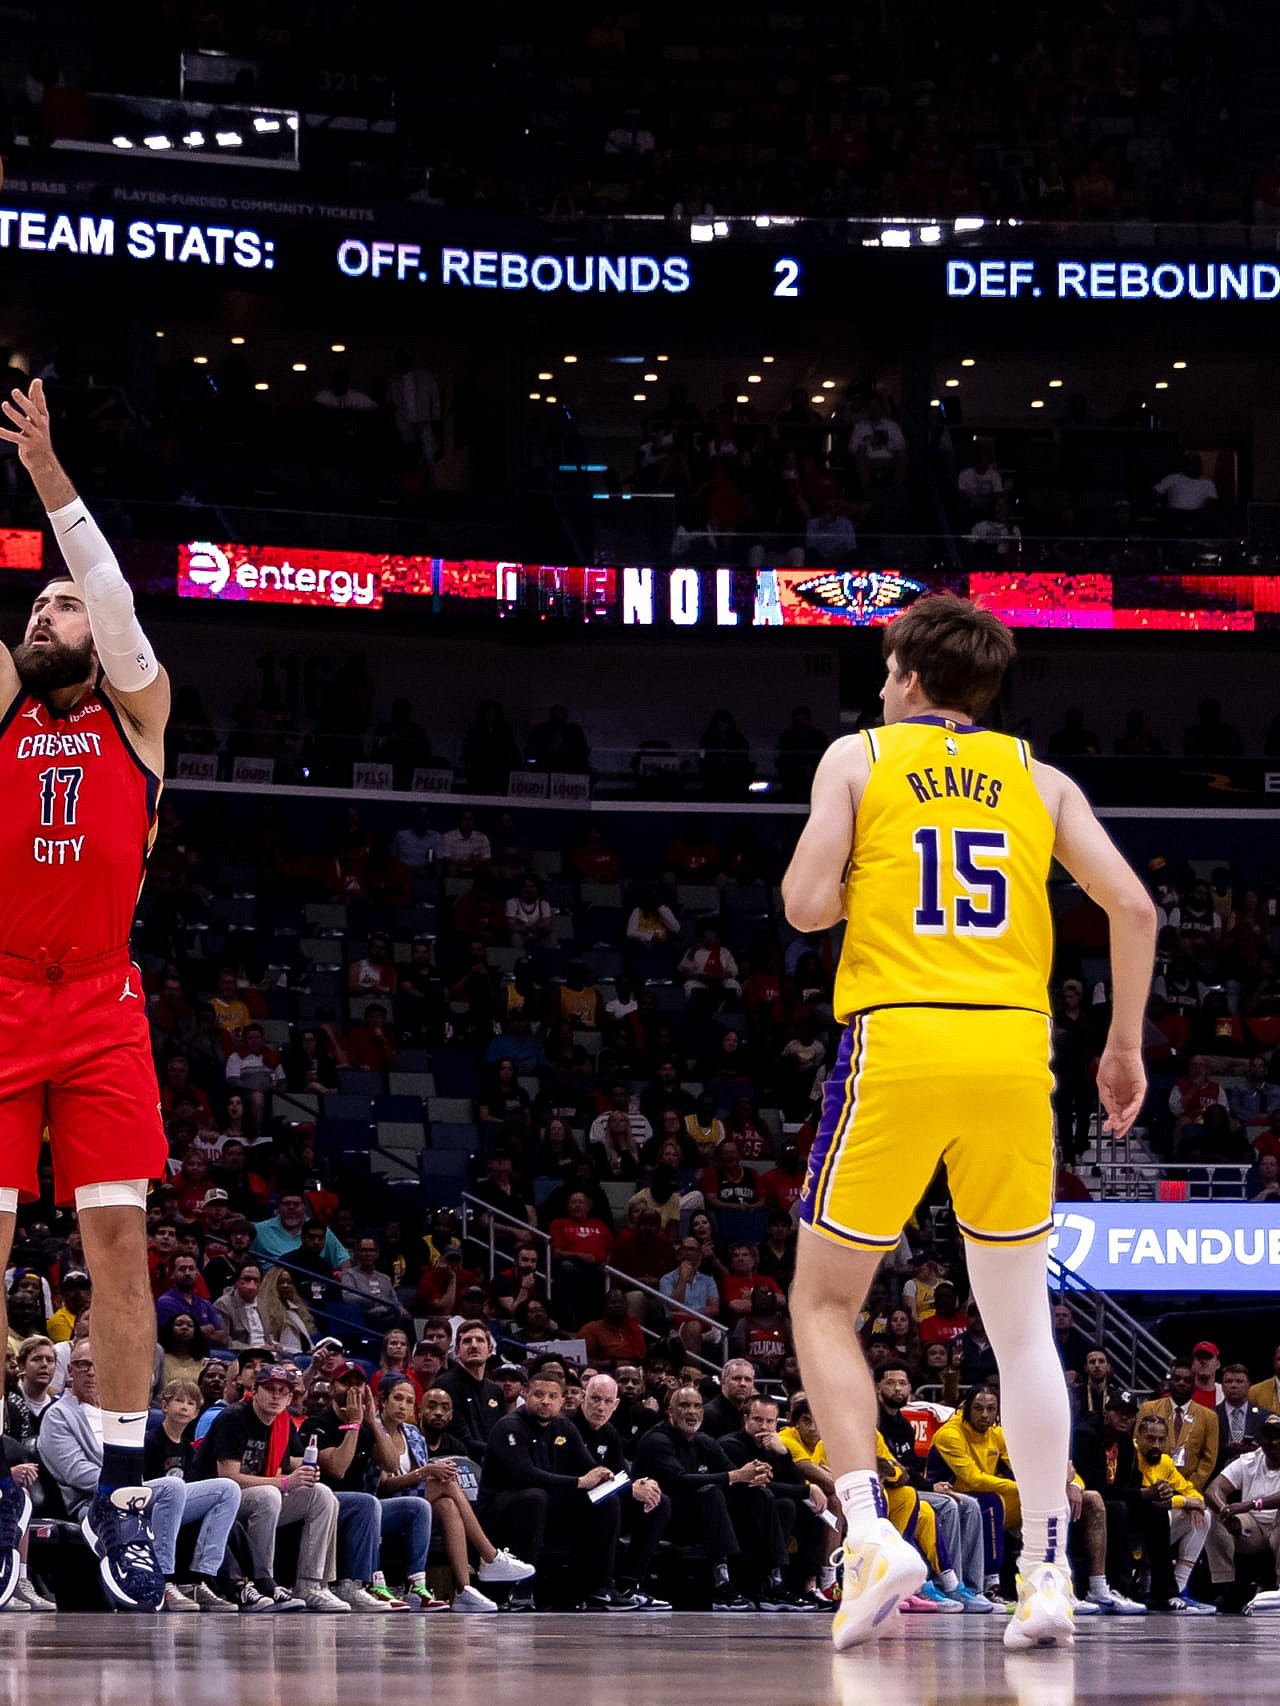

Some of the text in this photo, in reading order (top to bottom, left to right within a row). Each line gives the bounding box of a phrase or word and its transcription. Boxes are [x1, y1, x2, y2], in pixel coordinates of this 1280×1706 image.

[127, 221, 274, 269] STATS:
[338, 241, 798, 297] OFF. REBOUNDS 2
[948, 262, 1040, 296] DEF.
[236, 561, 374, 605] entergy
[38, 766, 83, 826] 17
[906, 767, 1002, 809] REAVES
[33, 835, 85, 865] CITY
[912, 826, 1010, 938] 15
